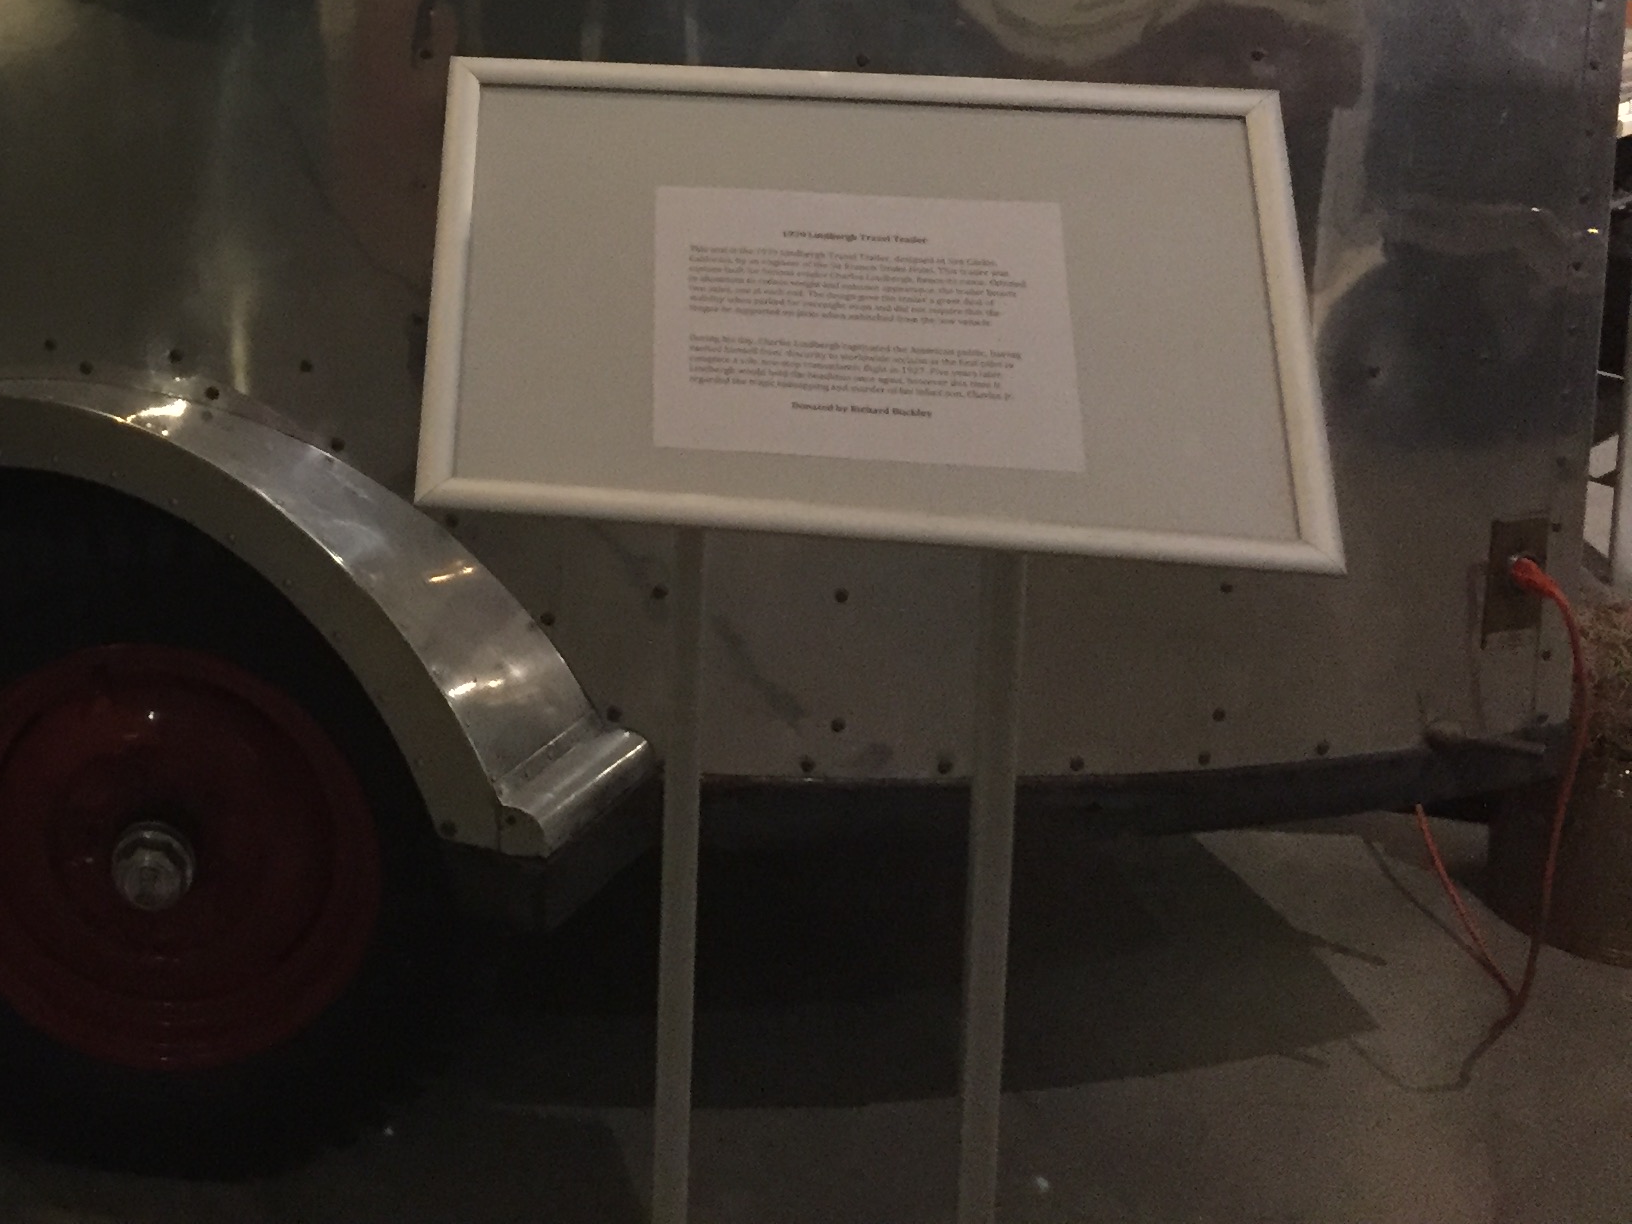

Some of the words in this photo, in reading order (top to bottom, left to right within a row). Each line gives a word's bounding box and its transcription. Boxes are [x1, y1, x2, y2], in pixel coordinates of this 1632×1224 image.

[860, 234, 890, 243] Travel
[894, 235, 927, 245] Trailer
[792, 401, 833, 411] Donated
[836, 404, 848, 414] by
[851, 405, 889, 415] Richard
